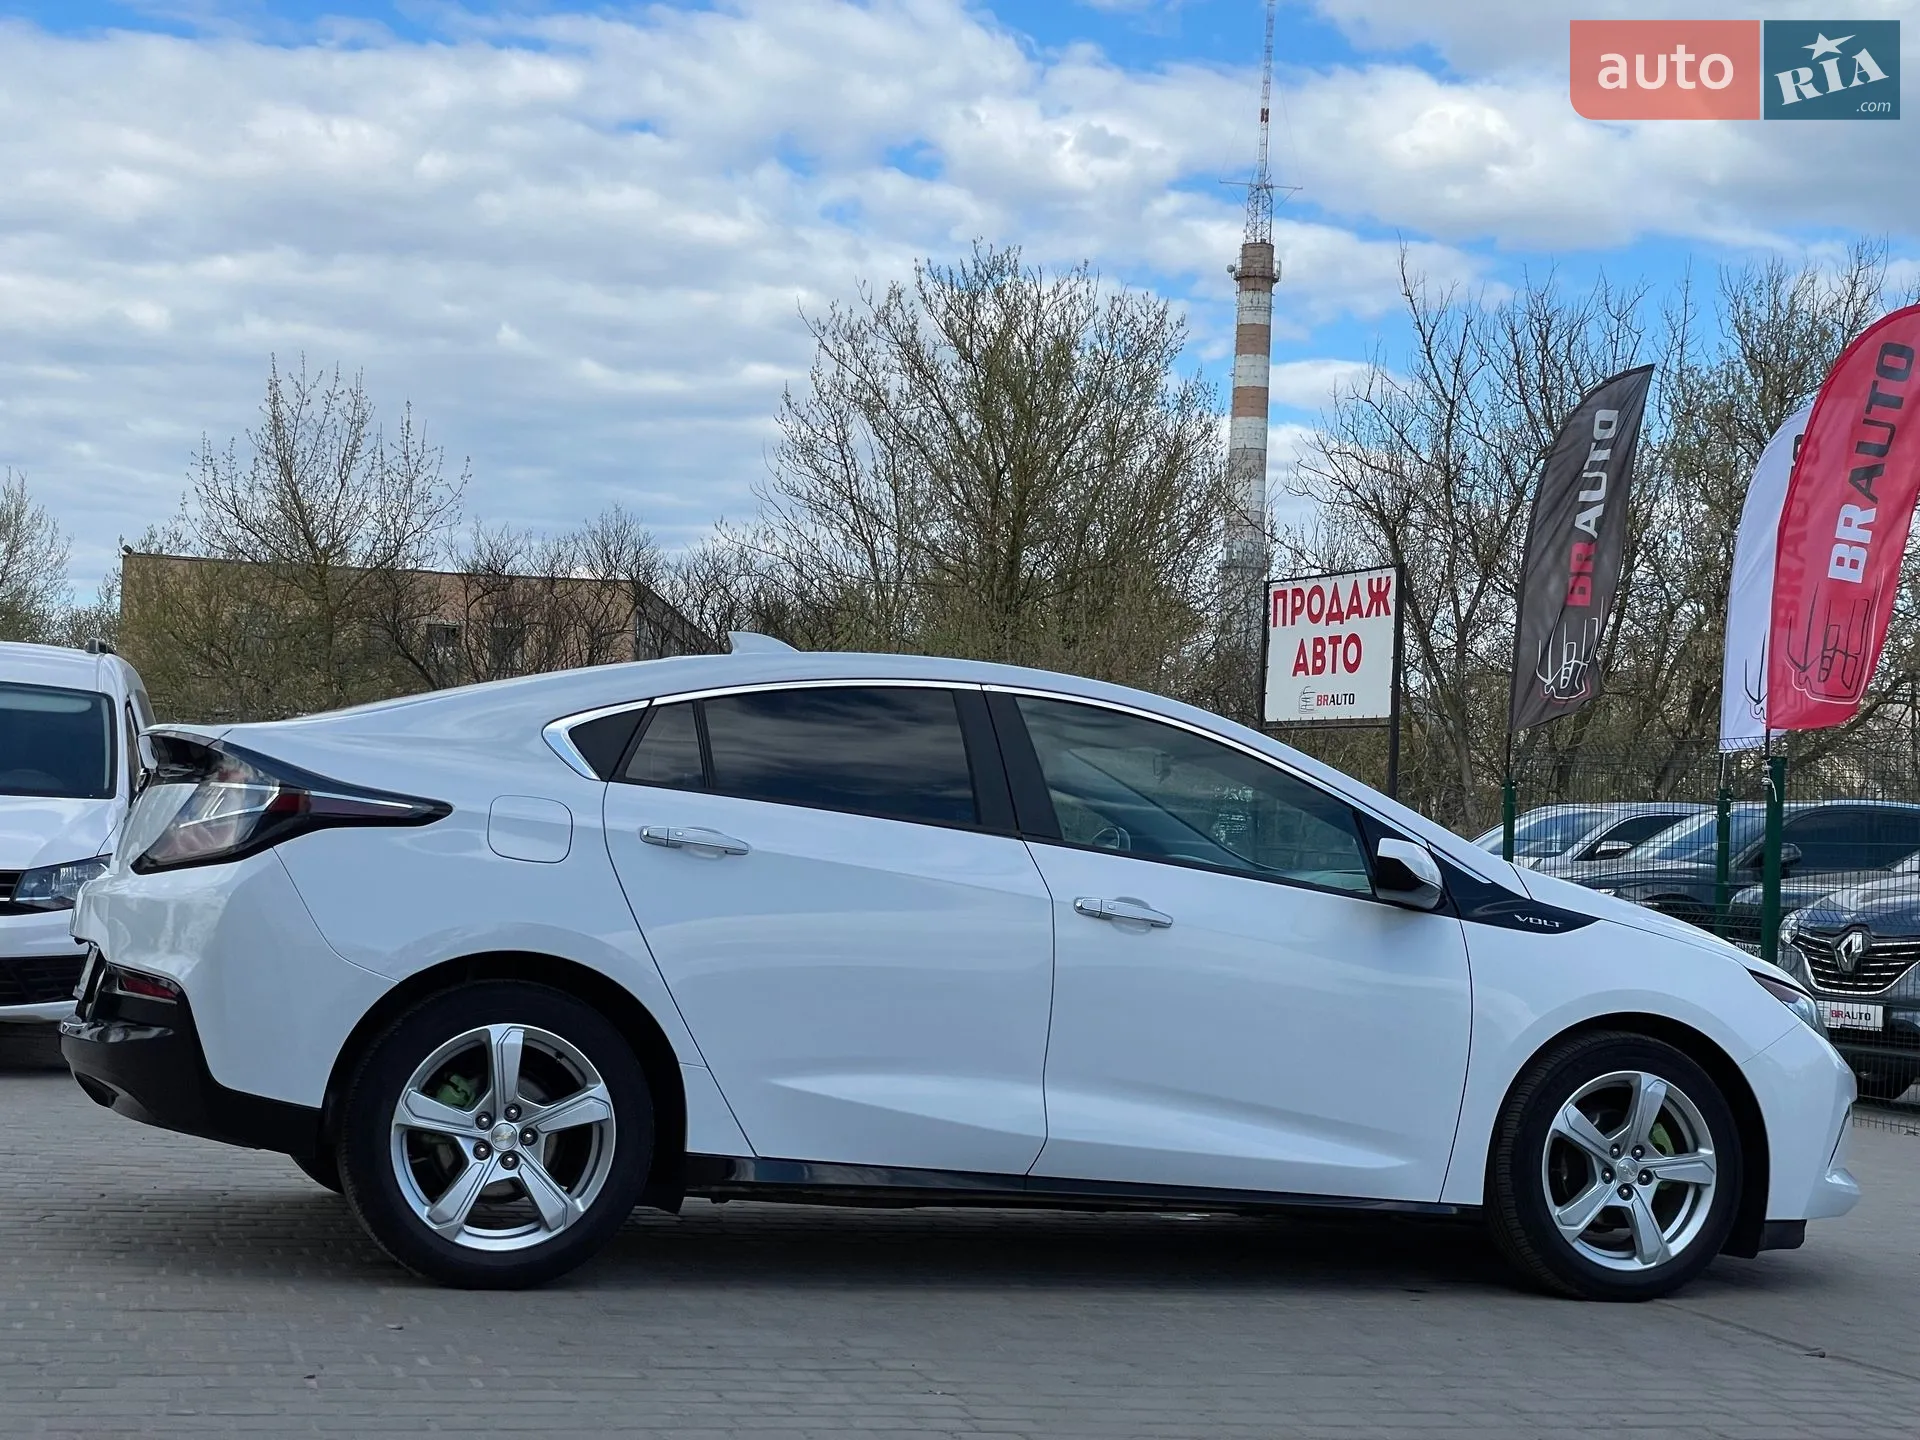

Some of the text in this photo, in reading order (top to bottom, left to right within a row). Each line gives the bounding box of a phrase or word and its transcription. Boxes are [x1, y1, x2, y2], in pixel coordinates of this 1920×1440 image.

[1828, 341, 1916, 584] BRAUTO
[1566, 408, 1620, 607] BRAUTO
[1272, 575, 1392, 628] ПРОДАЖ
[1291, 632, 1363, 677] АВТО
[1316, 693, 1355, 707] BRAUTO
[1513, 914, 1563, 928] VOLT
[1831, 1009, 1871, 1021] BRAUTO
